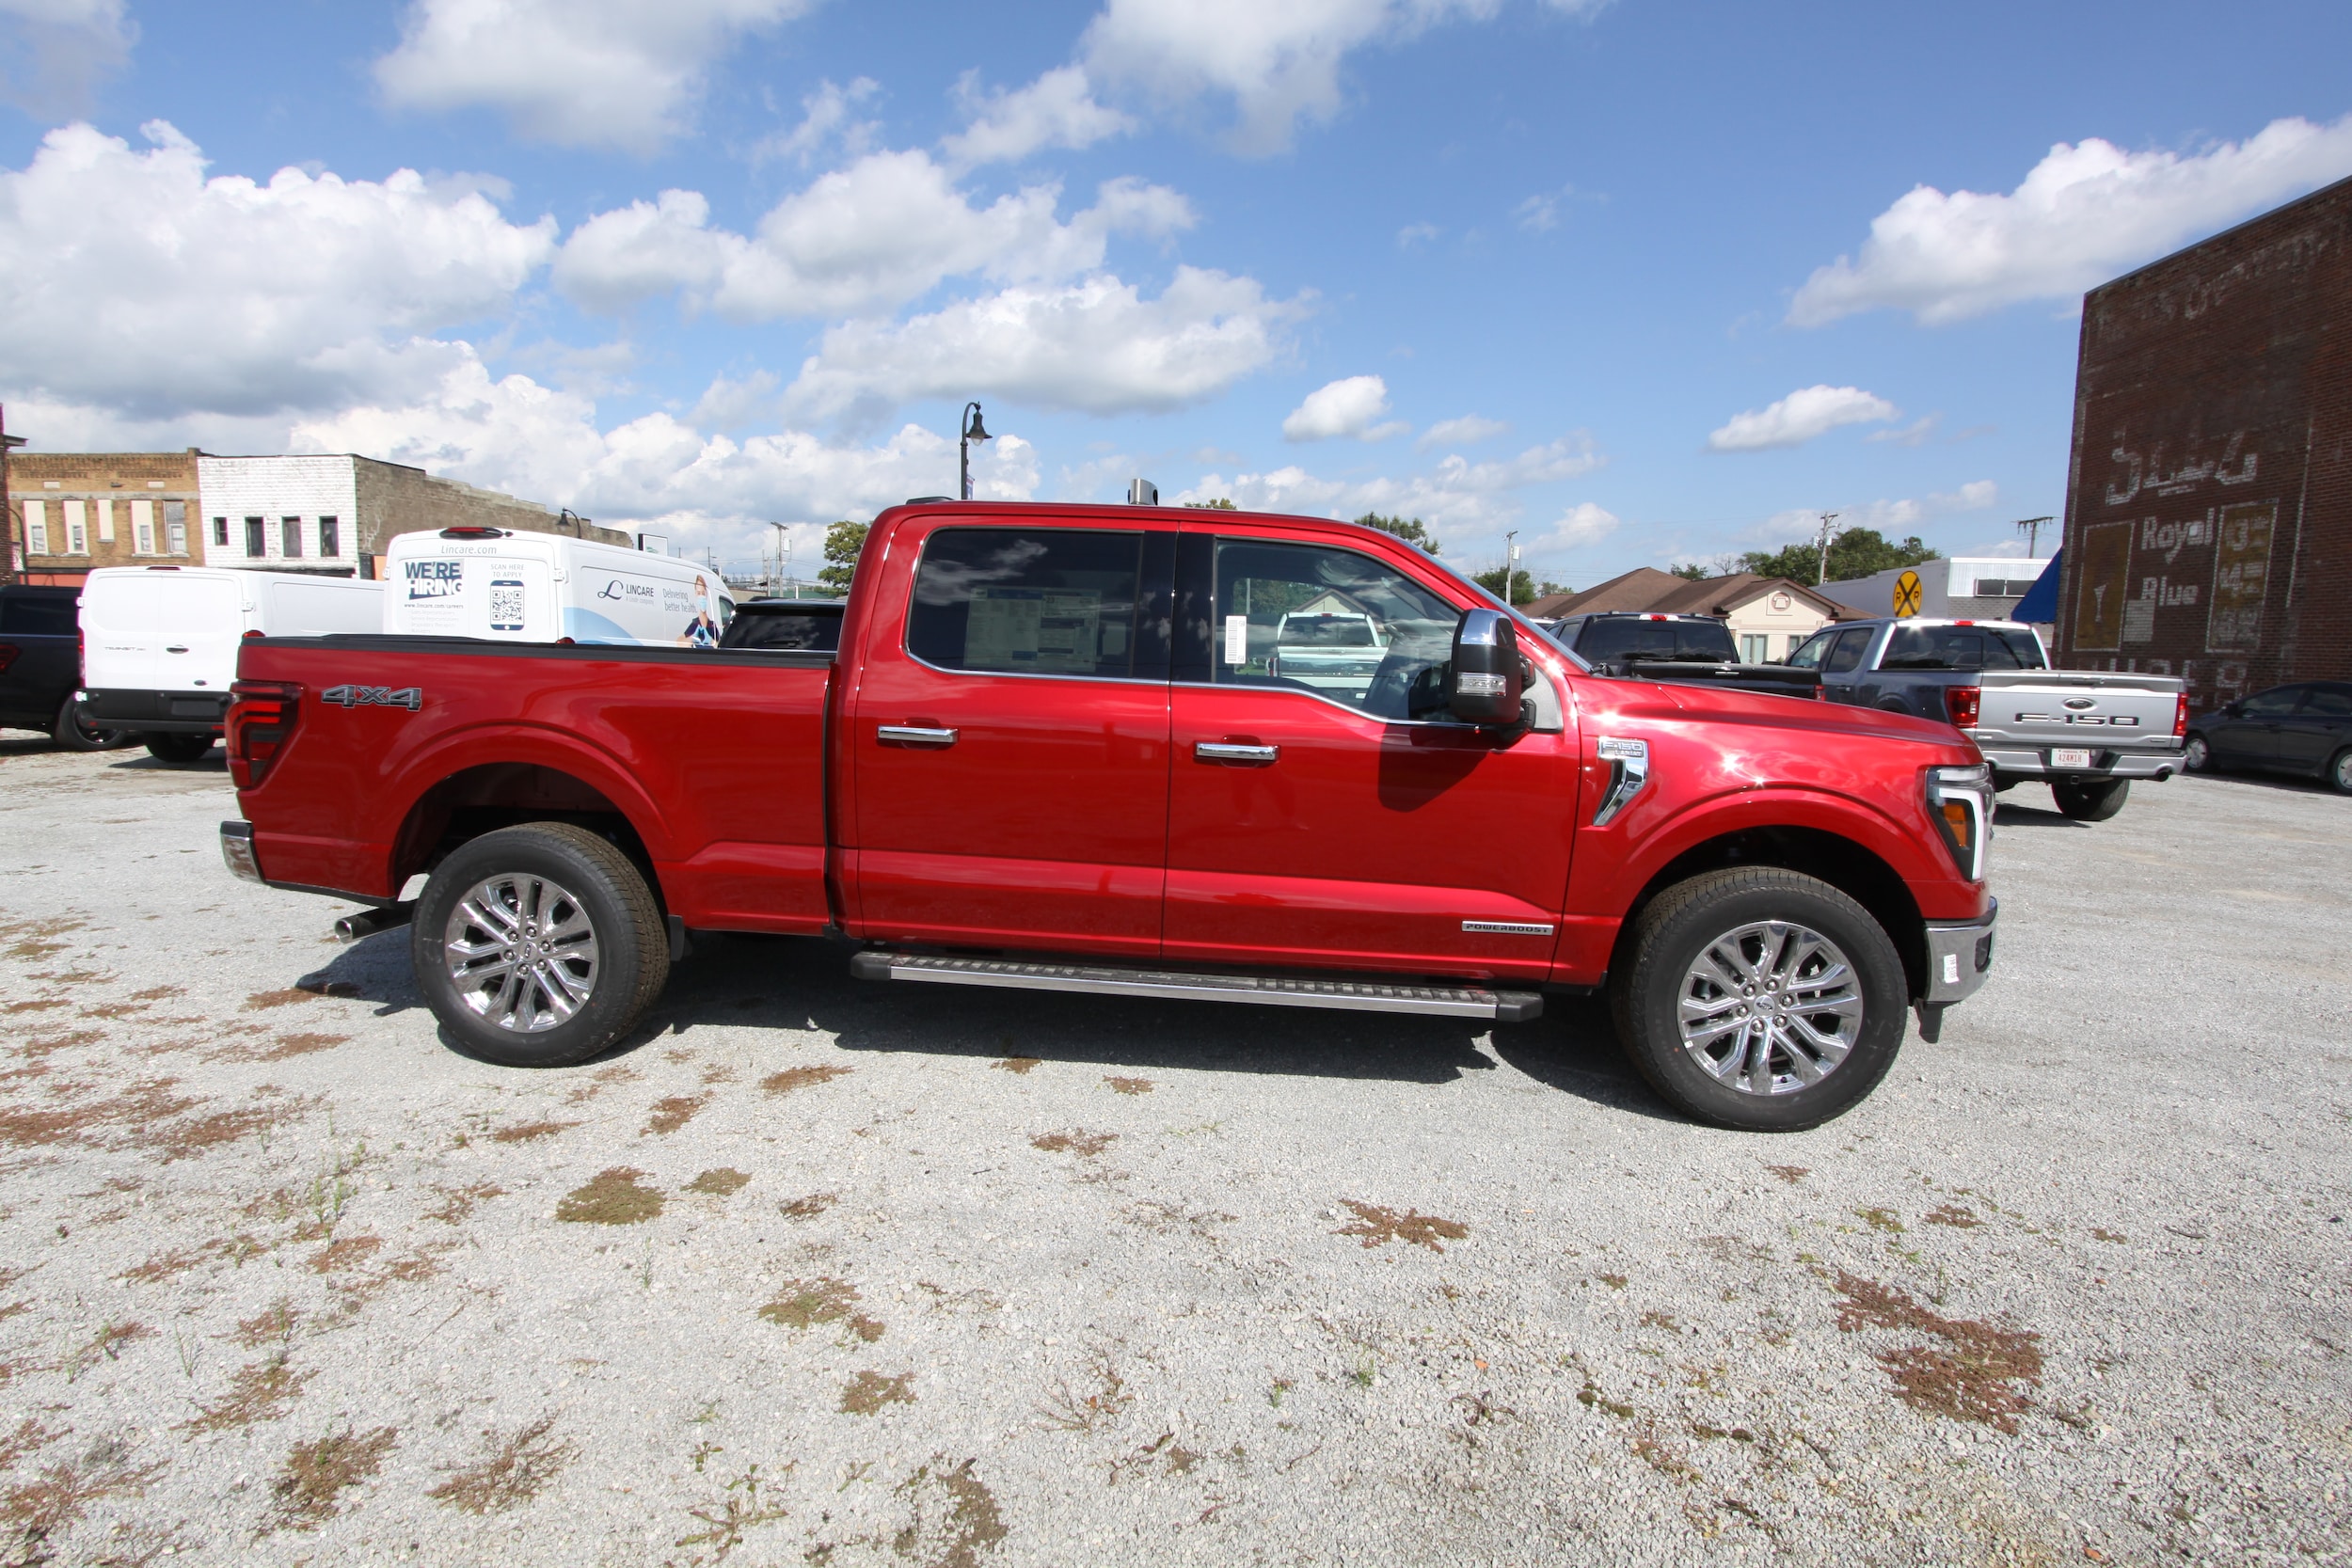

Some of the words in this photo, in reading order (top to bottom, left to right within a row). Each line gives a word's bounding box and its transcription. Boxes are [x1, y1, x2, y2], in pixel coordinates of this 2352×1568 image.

[2140, 507, 2215, 564] Royal
[440, 545, 498, 555] Lincare.com
[405, 562, 463, 579] WE'RE
[407, 578, 464, 595] HIRING
[626, 584, 655, 597] LINCARE
[2140, 575, 2199, 607] Blue
[662, 588, 689, 602] Delivering
[664, 601, 680, 611] better
[2013, 712, 2140, 727] F-150
[1602, 741, 1644, 752] F-150
[1466, 923, 1549, 934] POWERBOOST
